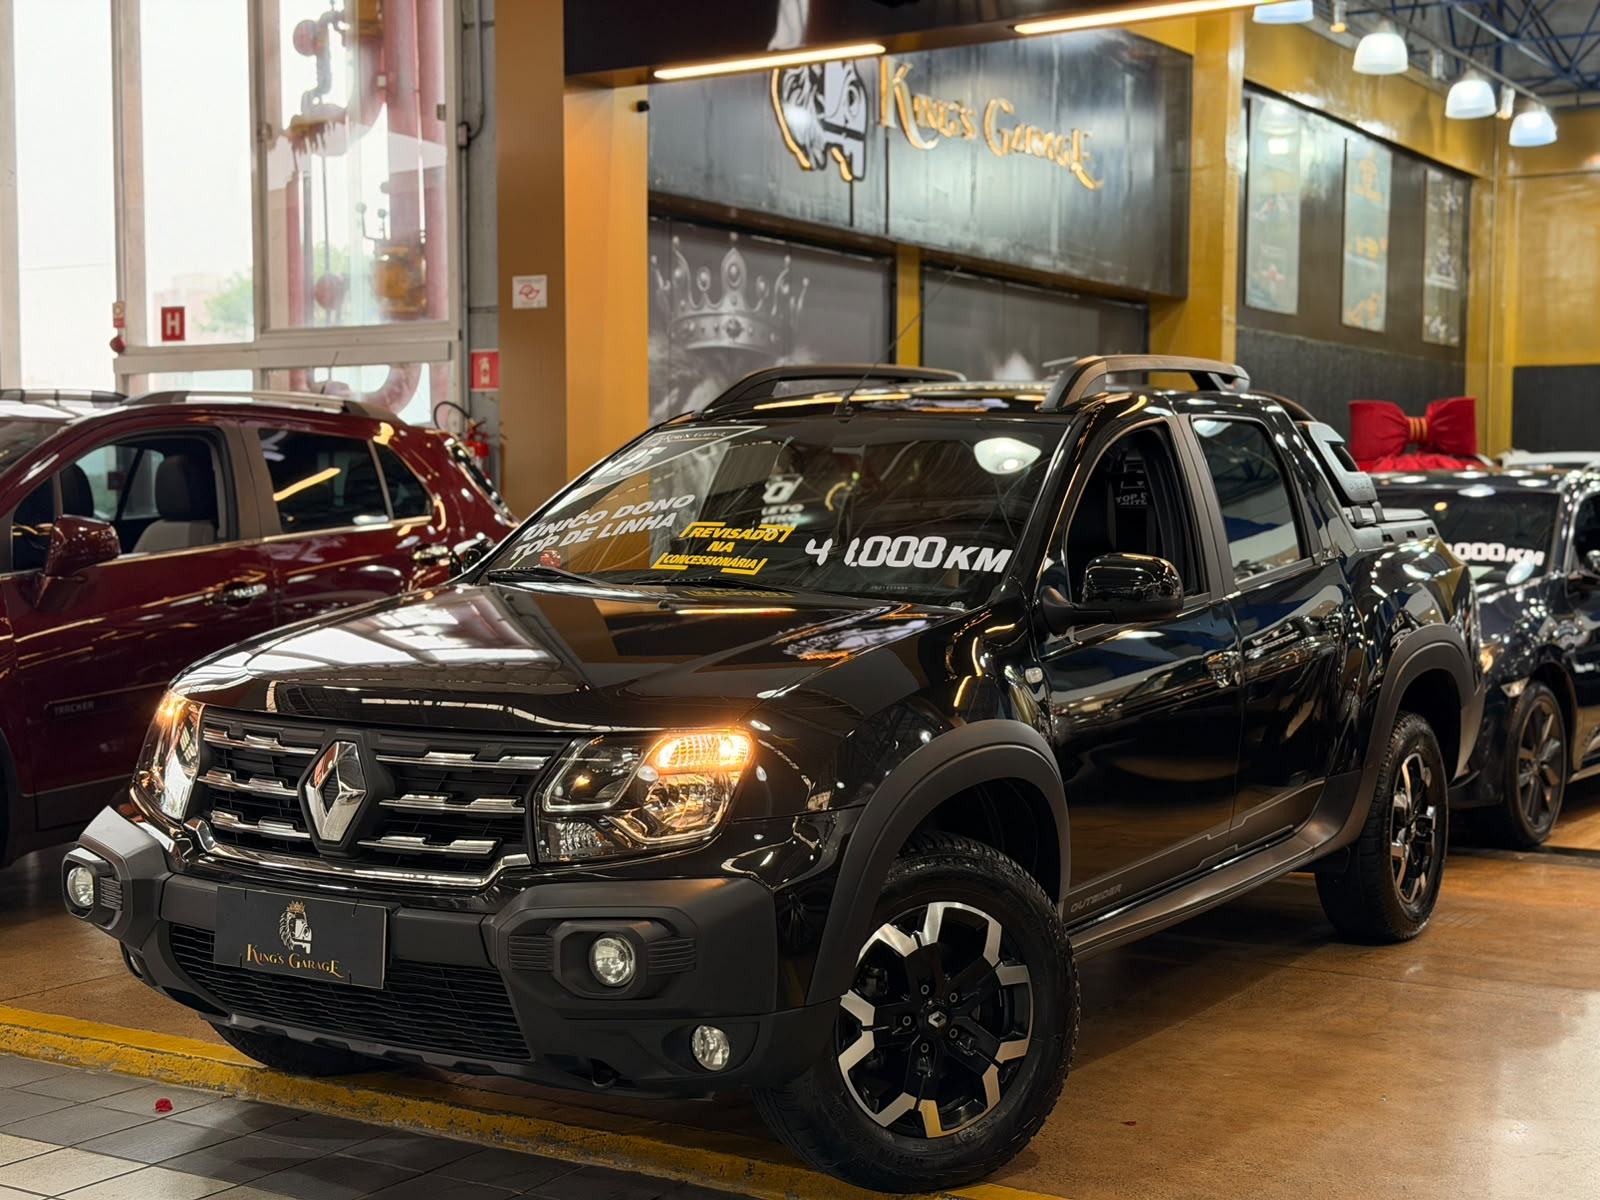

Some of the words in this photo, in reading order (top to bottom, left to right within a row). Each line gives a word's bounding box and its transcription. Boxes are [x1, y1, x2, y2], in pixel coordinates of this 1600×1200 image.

[611, 494, 695, 520] DONO
[509, 533, 559, 561] TOP
[559, 526, 596, 547] DE
[597, 512, 677, 540] LINHA
[688, 527, 780, 542] REVISADO
[706, 541, 736, 553] NA
[663, 553, 759, 570] CONCESSIONÁRIA
